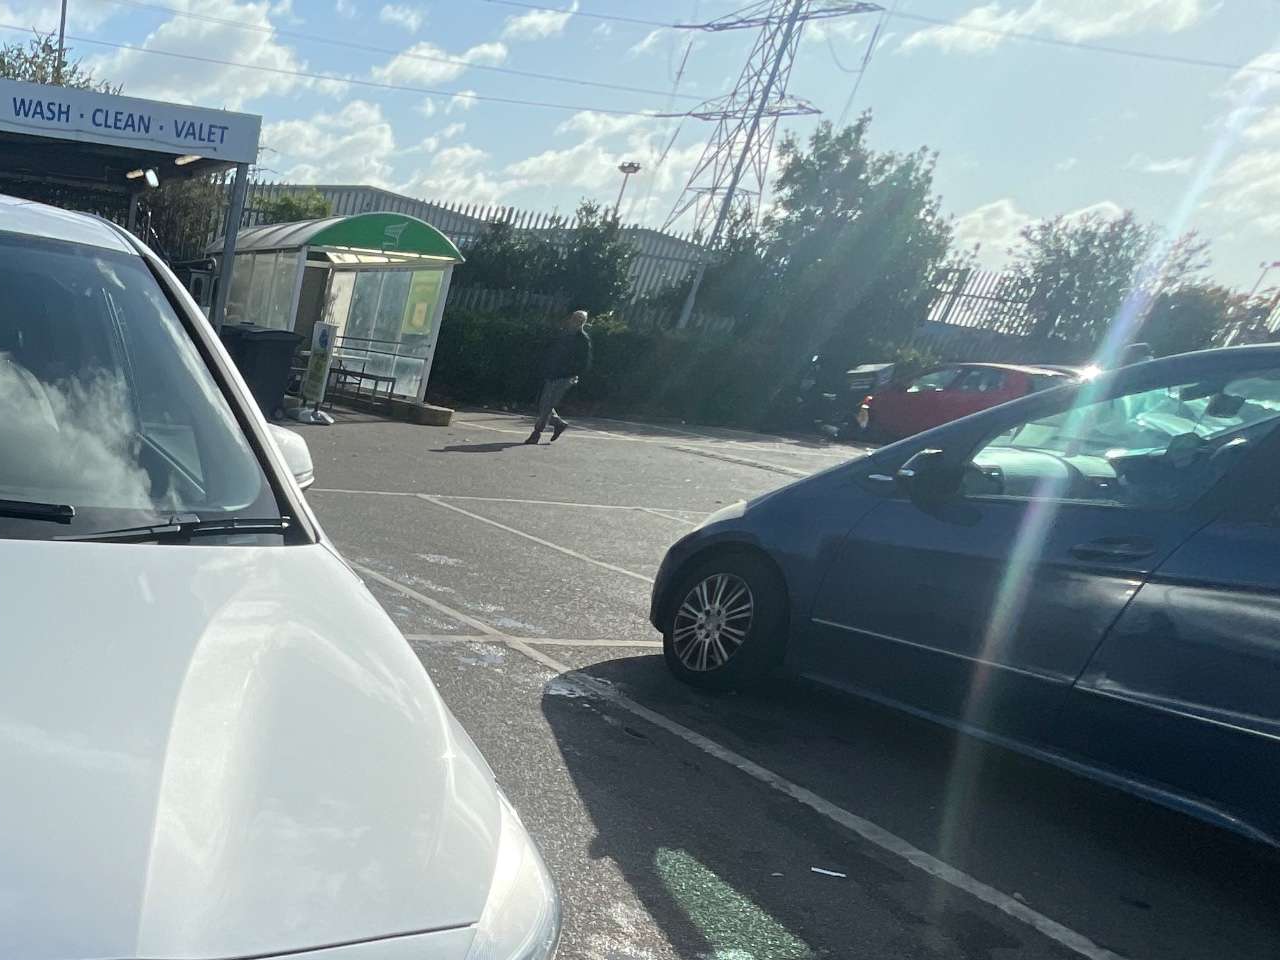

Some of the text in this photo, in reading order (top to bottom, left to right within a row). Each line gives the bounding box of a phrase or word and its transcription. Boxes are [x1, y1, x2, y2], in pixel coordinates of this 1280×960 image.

[12, 96, 229, 145] WASH CLEAN VALET
